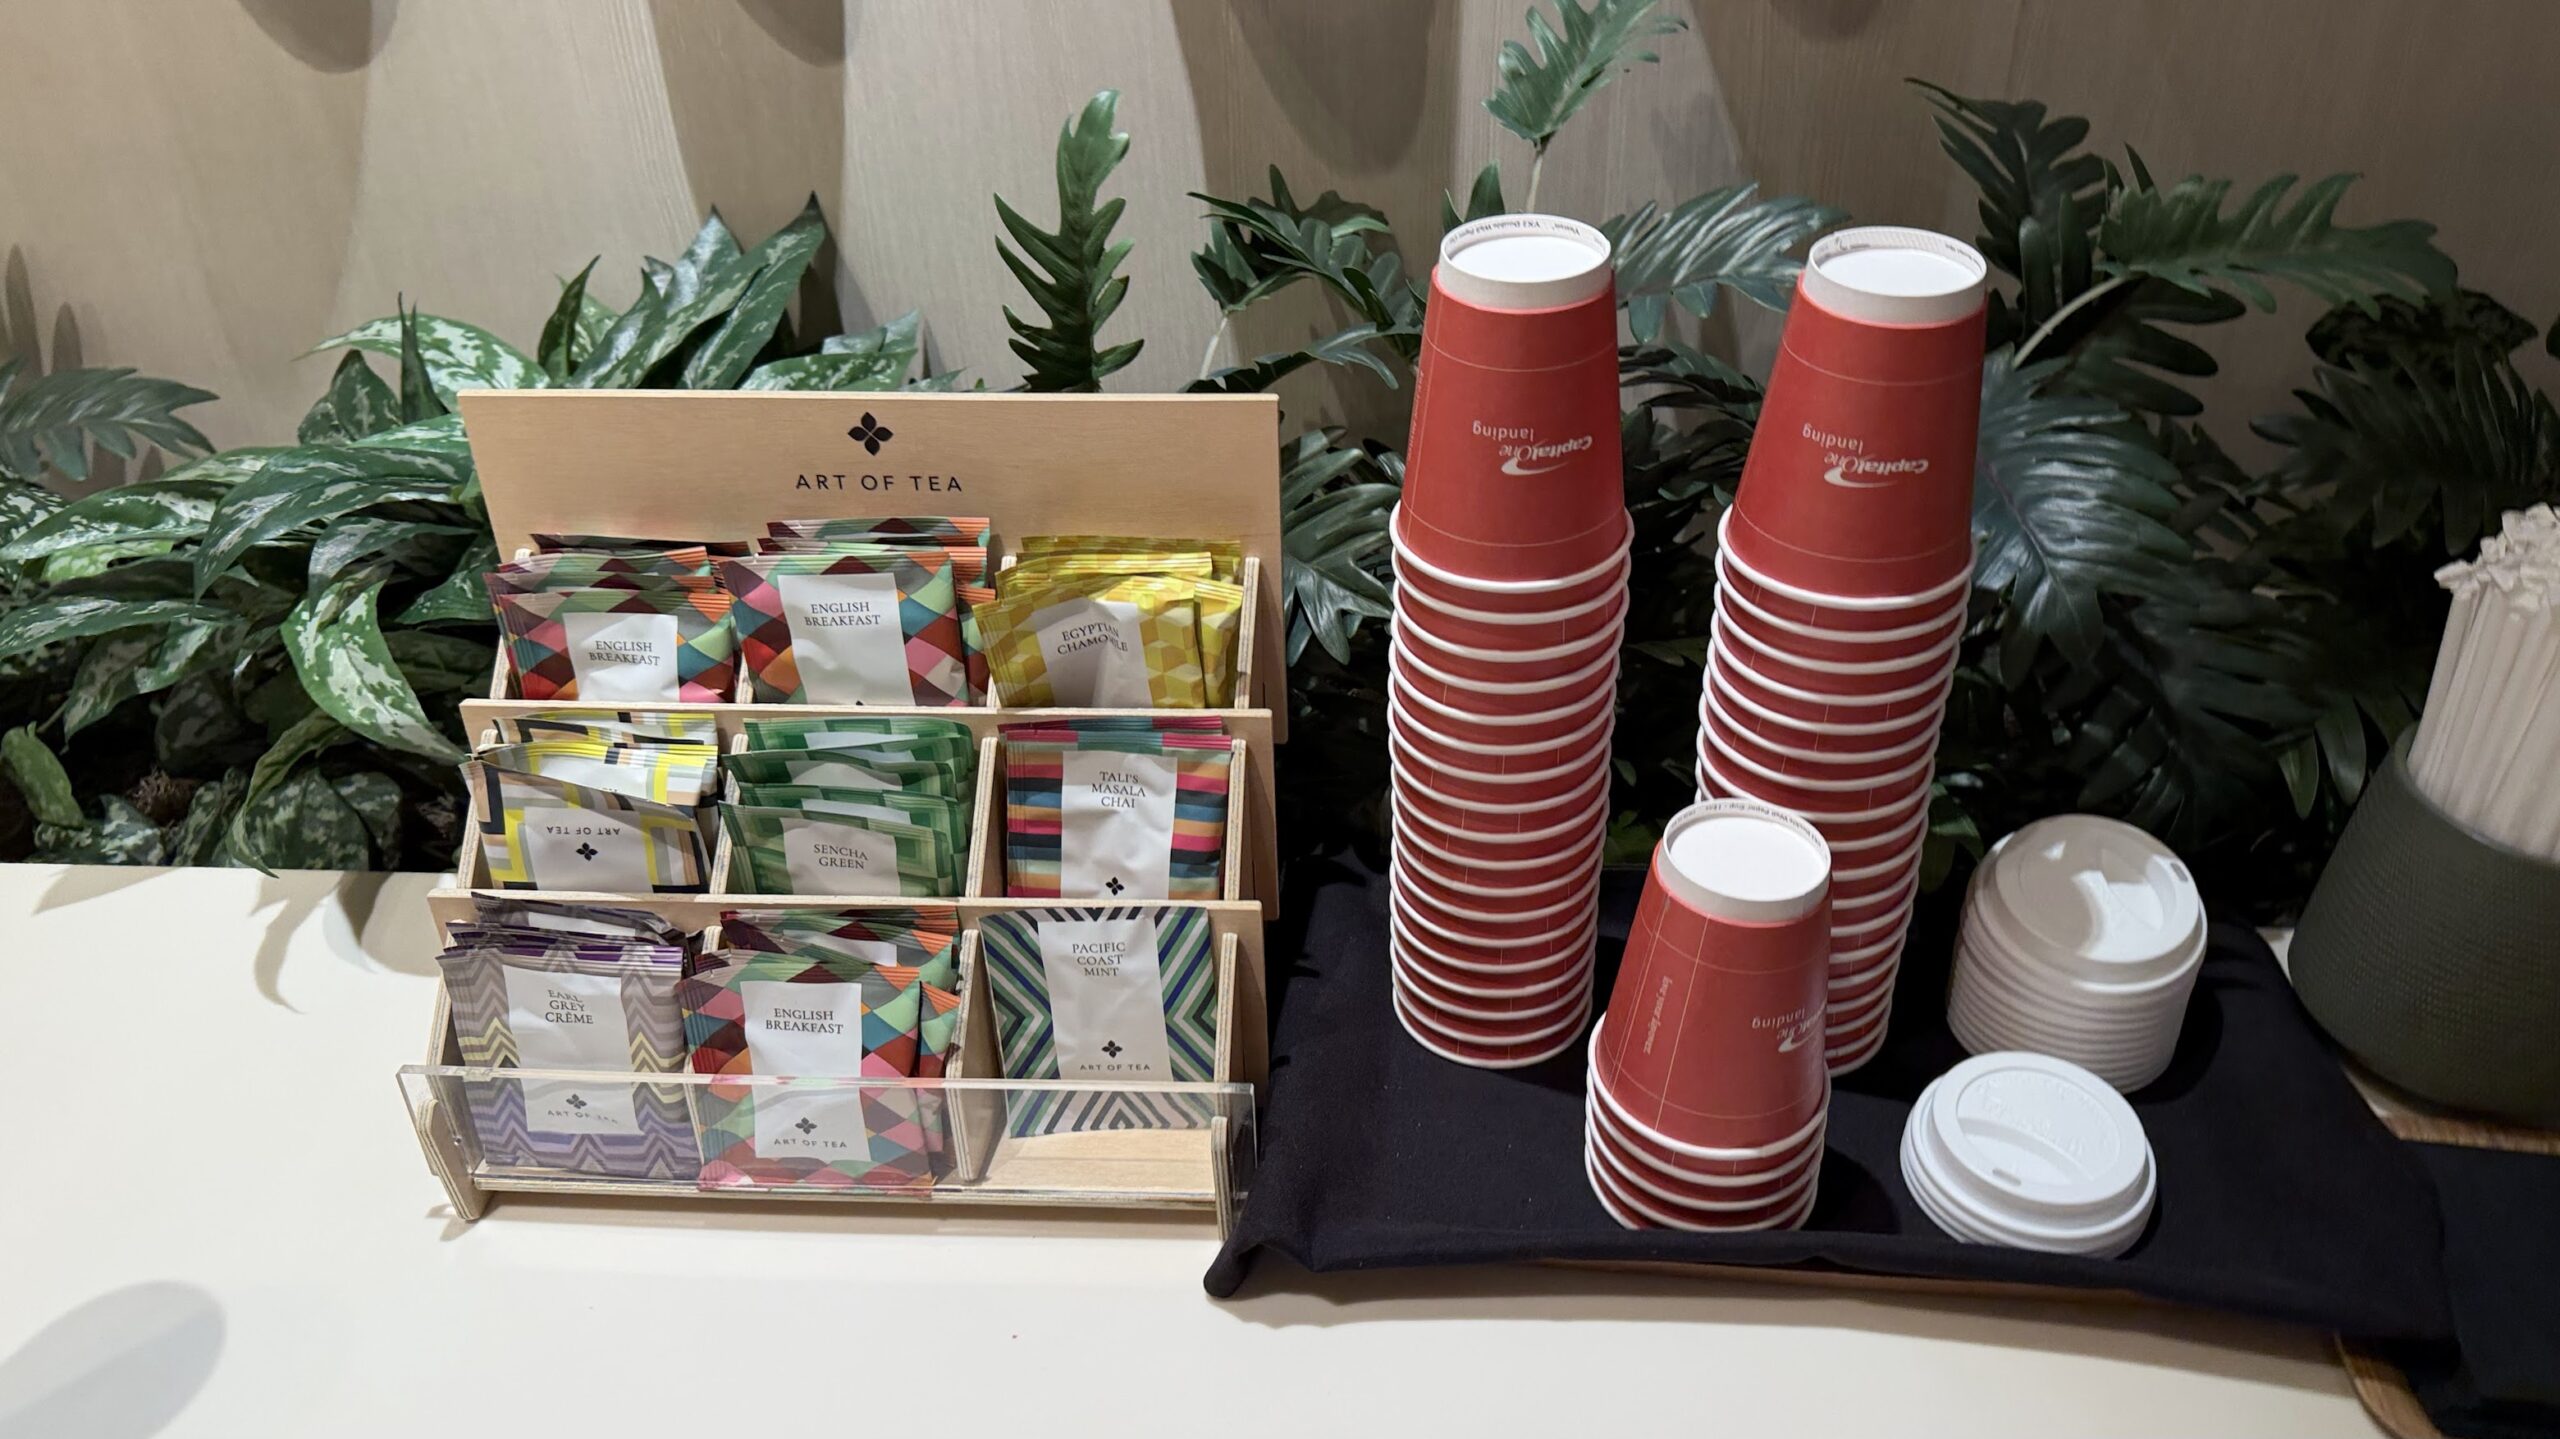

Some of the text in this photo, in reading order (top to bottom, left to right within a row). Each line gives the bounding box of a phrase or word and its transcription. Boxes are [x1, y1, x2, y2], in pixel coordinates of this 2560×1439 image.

[1472, 419, 1534, 442] landing
[1802, 422, 1864, 455] landing
[795, 474, 962, 492] ART OF TEA
[810, 602, 870, 614] ENGLISH
[804, 614, 881, 627] BREAKFAST
[595, 640, 652, 652] ENGLISH
[588, 652, 660, 666] BREAKFAST
[1099, 771, 1140, 784] TALI'S
[1091, 783, 1146, 797] MASALA
[1101, 796, 1135, 808] CHAI
[546, 826, 621, 836] ART OF TEA
[813, 844, 869, 861] SENCHA
[818, 856, 865, 870] GREEN
[1072, 941, 1126, 954] PACIFIC
[1077, 954, 1123, 966] COAST
[1083, 967, 1120, 977] MINT
[547, 989, 584, 1003] EARL
[549, 1000, 585, 1012] GREY
[773, 1007, 834, 1021] ENGLISH
[1751, 1008, 1806, 1029] landing
[765, 1019, 844, 1035] BREAKFAST
[1079, 1063, 1151, 1071] ART OF TEA
[774, 1138, 848, 1149] ART OF TEA
